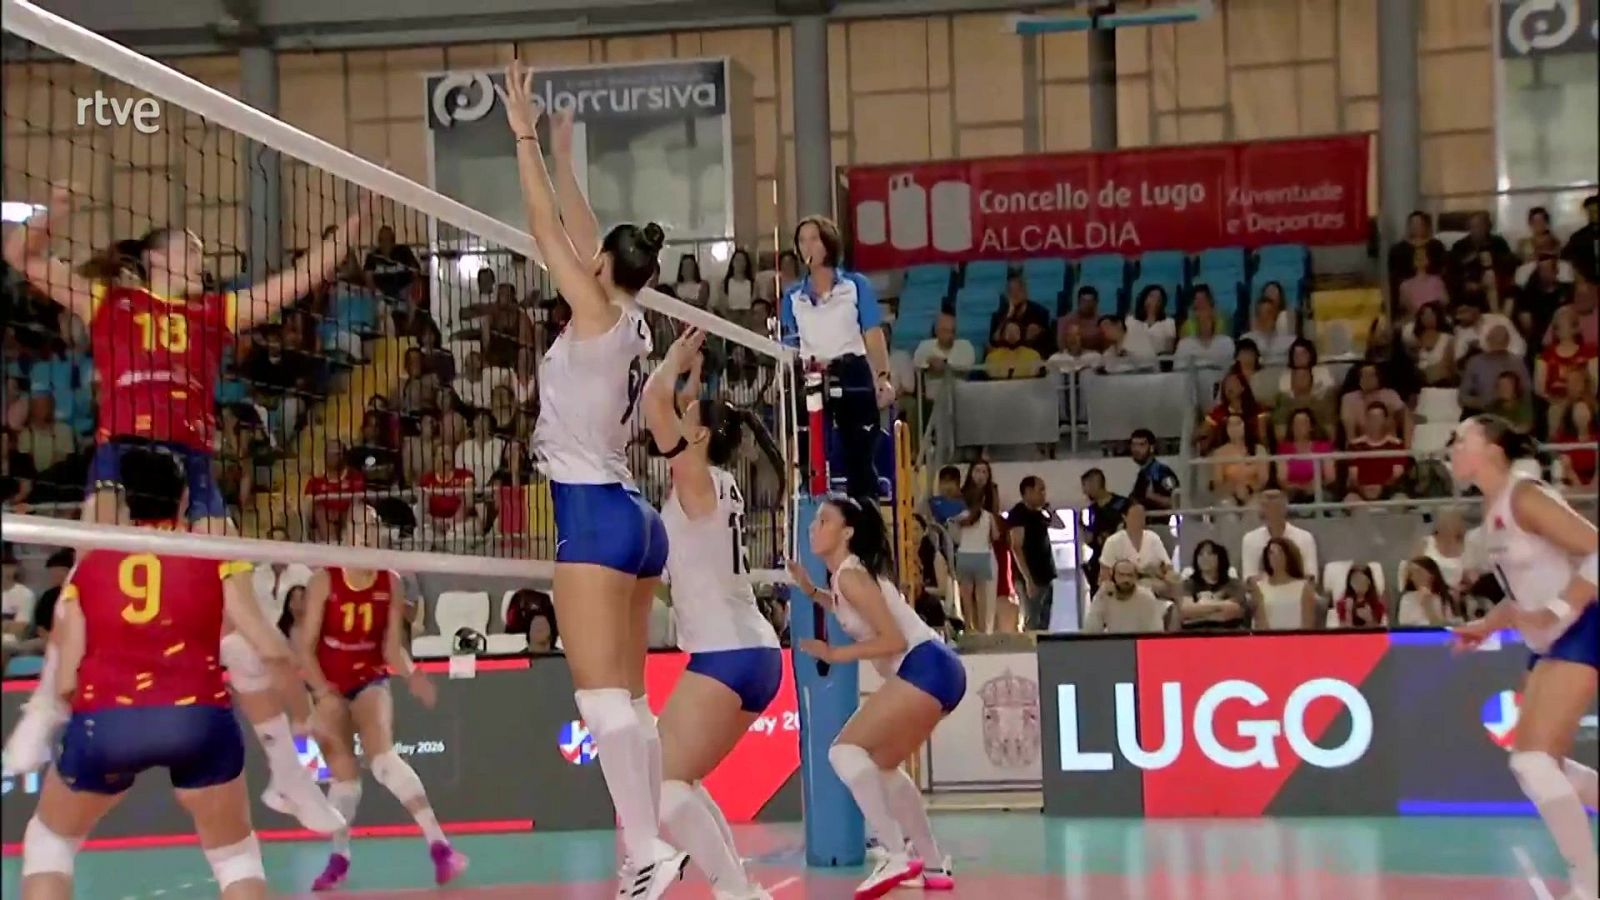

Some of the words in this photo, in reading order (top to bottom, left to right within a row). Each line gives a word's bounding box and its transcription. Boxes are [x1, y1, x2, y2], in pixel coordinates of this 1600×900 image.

[979, 182, 1088, 214] Concello
[1098, 179, 1131, 208] de
[1141, 180, 1206, 211] Lugo
[1226, 181, 1344, 206] Xuventude
[979, 220, 1141, 252] ALCALDIA
[1226, 219, 1240, 234] e
[1246, 212, 1344, 233] Deportes
[133, 312, 188, 353] 18
[118, 552, 162, 624] 9
[340, 602, 373, 632] 11
[1057, 678, 1373, 770] LUGO
[417, 740, 446, 754] 2026
